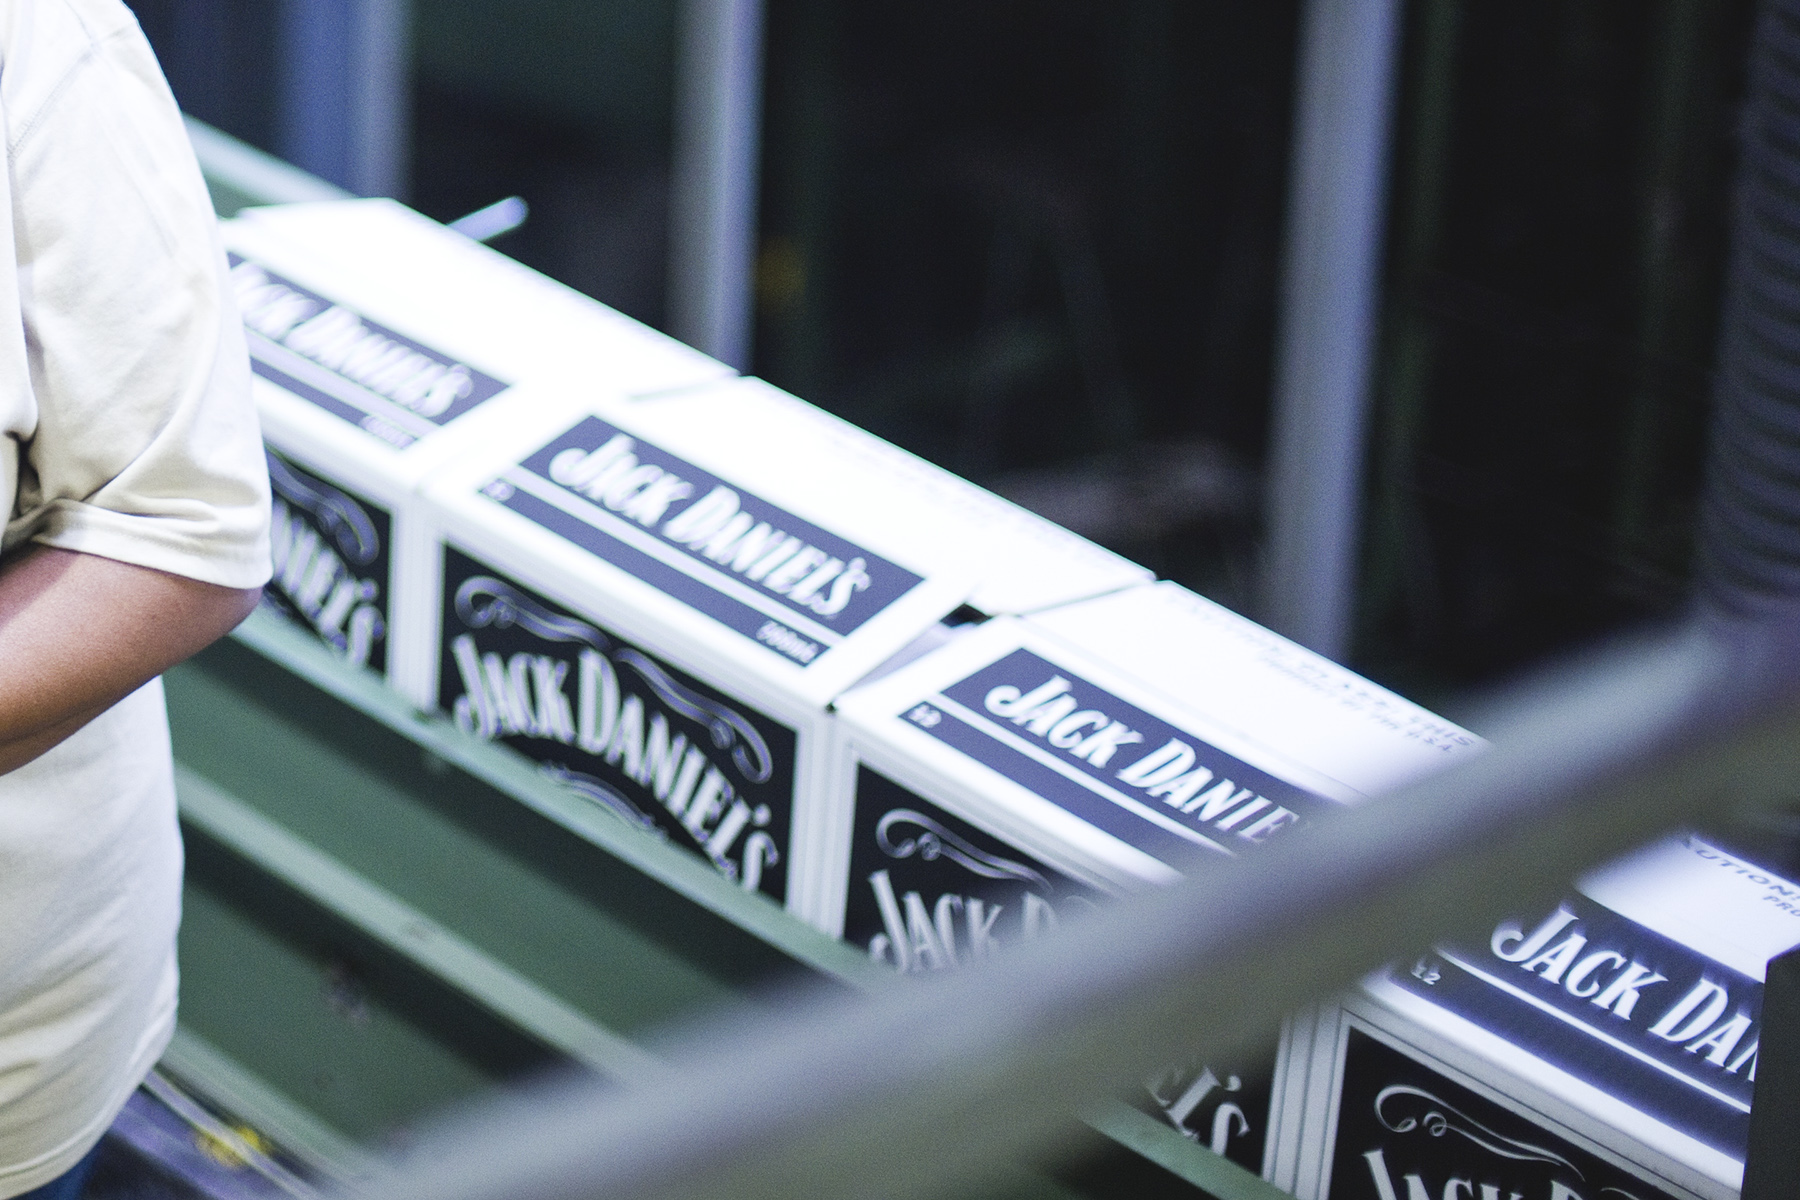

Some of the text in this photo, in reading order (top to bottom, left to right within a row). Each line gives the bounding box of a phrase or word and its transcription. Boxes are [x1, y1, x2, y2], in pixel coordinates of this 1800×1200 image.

[549, 433, 696, 527] JACK
[663, 484, 872, 617] DANIEL'S
[452, 632, 780, 894] JACK DANIEL'S
[984, 674, 1144, 769] JACK
[1490, 906, 1669, 1021] JACK
